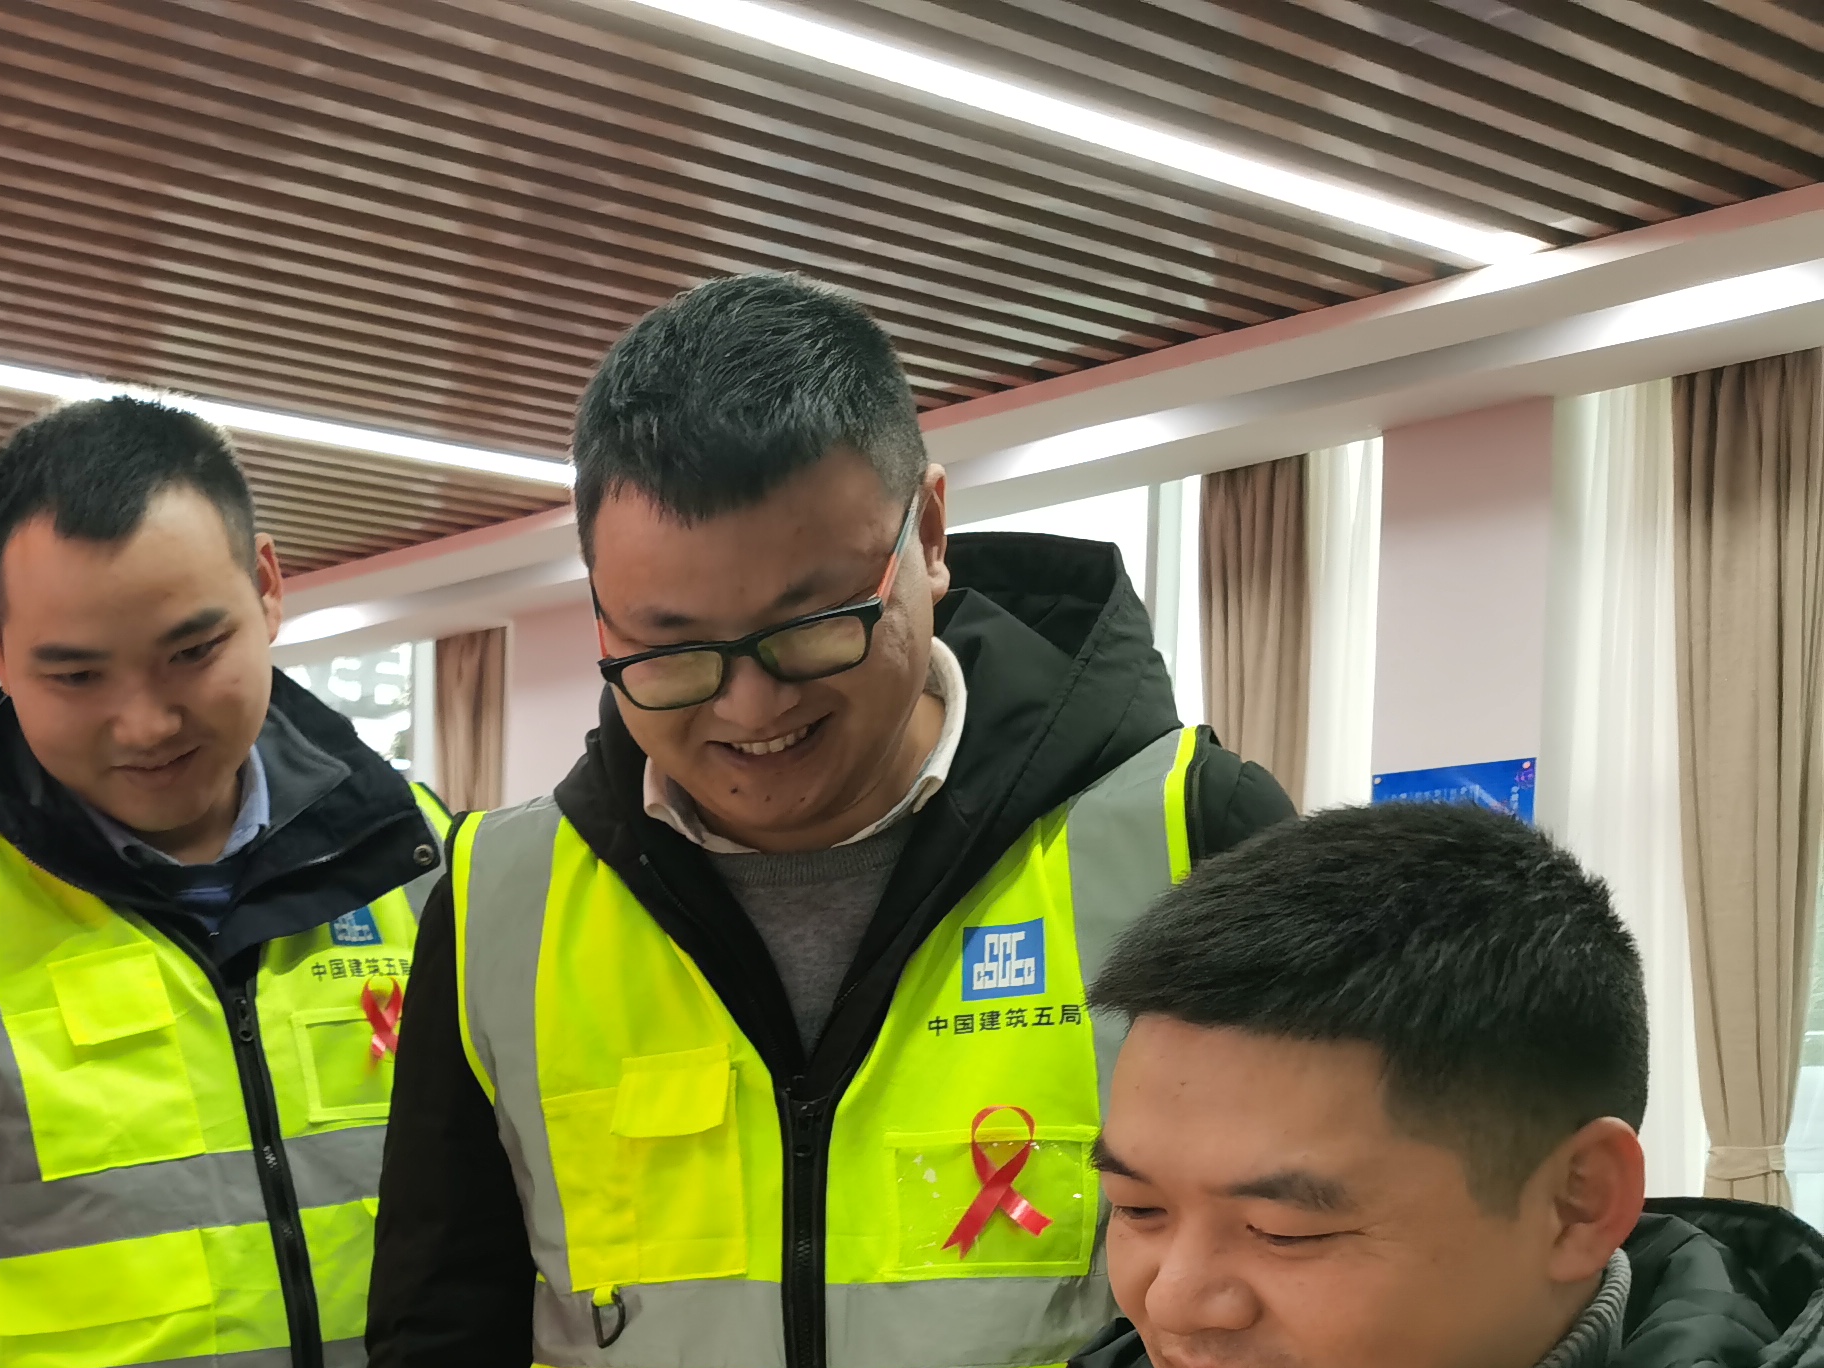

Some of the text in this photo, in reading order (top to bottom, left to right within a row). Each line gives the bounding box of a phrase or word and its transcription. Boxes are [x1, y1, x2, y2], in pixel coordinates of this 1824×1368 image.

[928, 1004, 1082, 1037] 中国建筑五局
